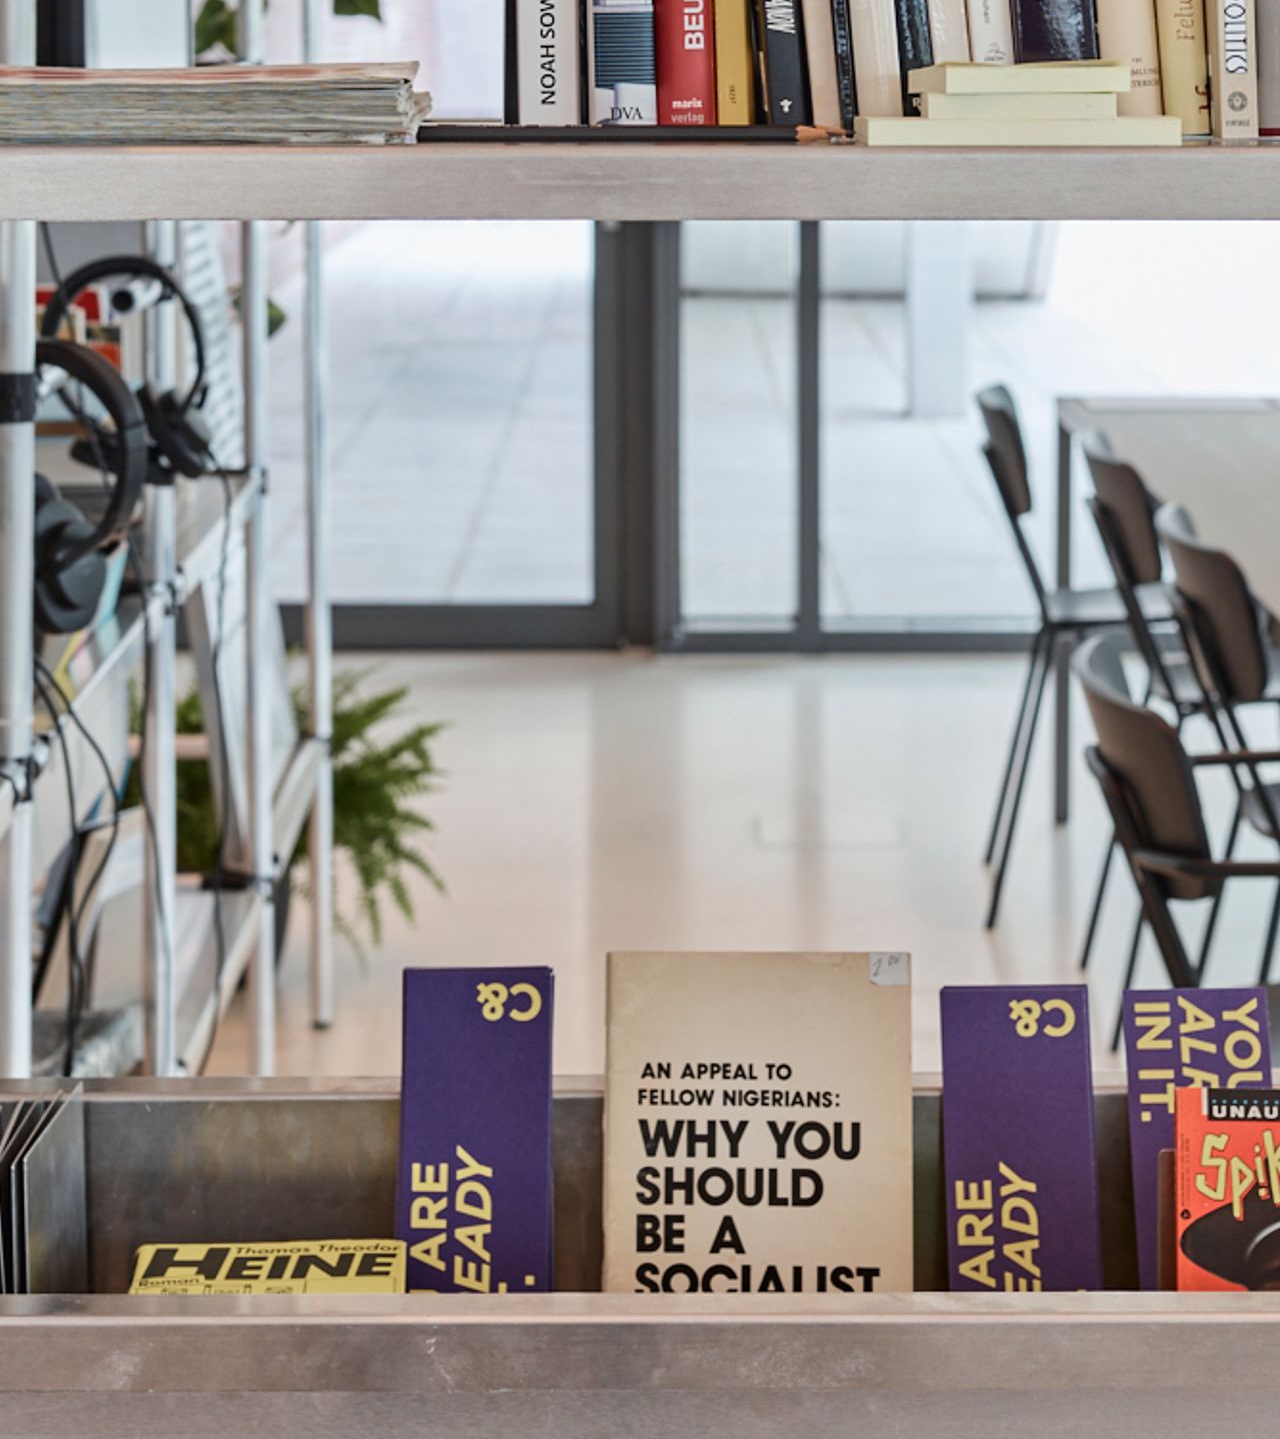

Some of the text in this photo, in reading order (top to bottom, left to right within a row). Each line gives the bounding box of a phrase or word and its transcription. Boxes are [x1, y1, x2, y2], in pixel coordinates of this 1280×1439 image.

[539, 44, 556, 106] NOAH
[610, 106, 643, 121] DVA
[641, 1062, 793, 1081] AN APPEAL TO
[1134, 1001, 1176, 1123] IN IT.
[637, 1088, 841, 1108] FELLOW NIGERIANS:
[638, 1118, 861, 1161] WHY YOU
[635, 1166, 824, 1207] SHOULD
[410, 1162, 449, 1272] ARE
[454, 1144, 494, 1293] EADY
[636, 1214, 747, 1255] BE A
[955, 1179, 997, 1289] ARE
[140, 1247, 398, 1281] HEINE
[236, 1243, 401, 1255] Thomas Theodor
[138, 1277, 200, 1288] Roman
[634, 1262, 881, 1293] SOCIALIST
